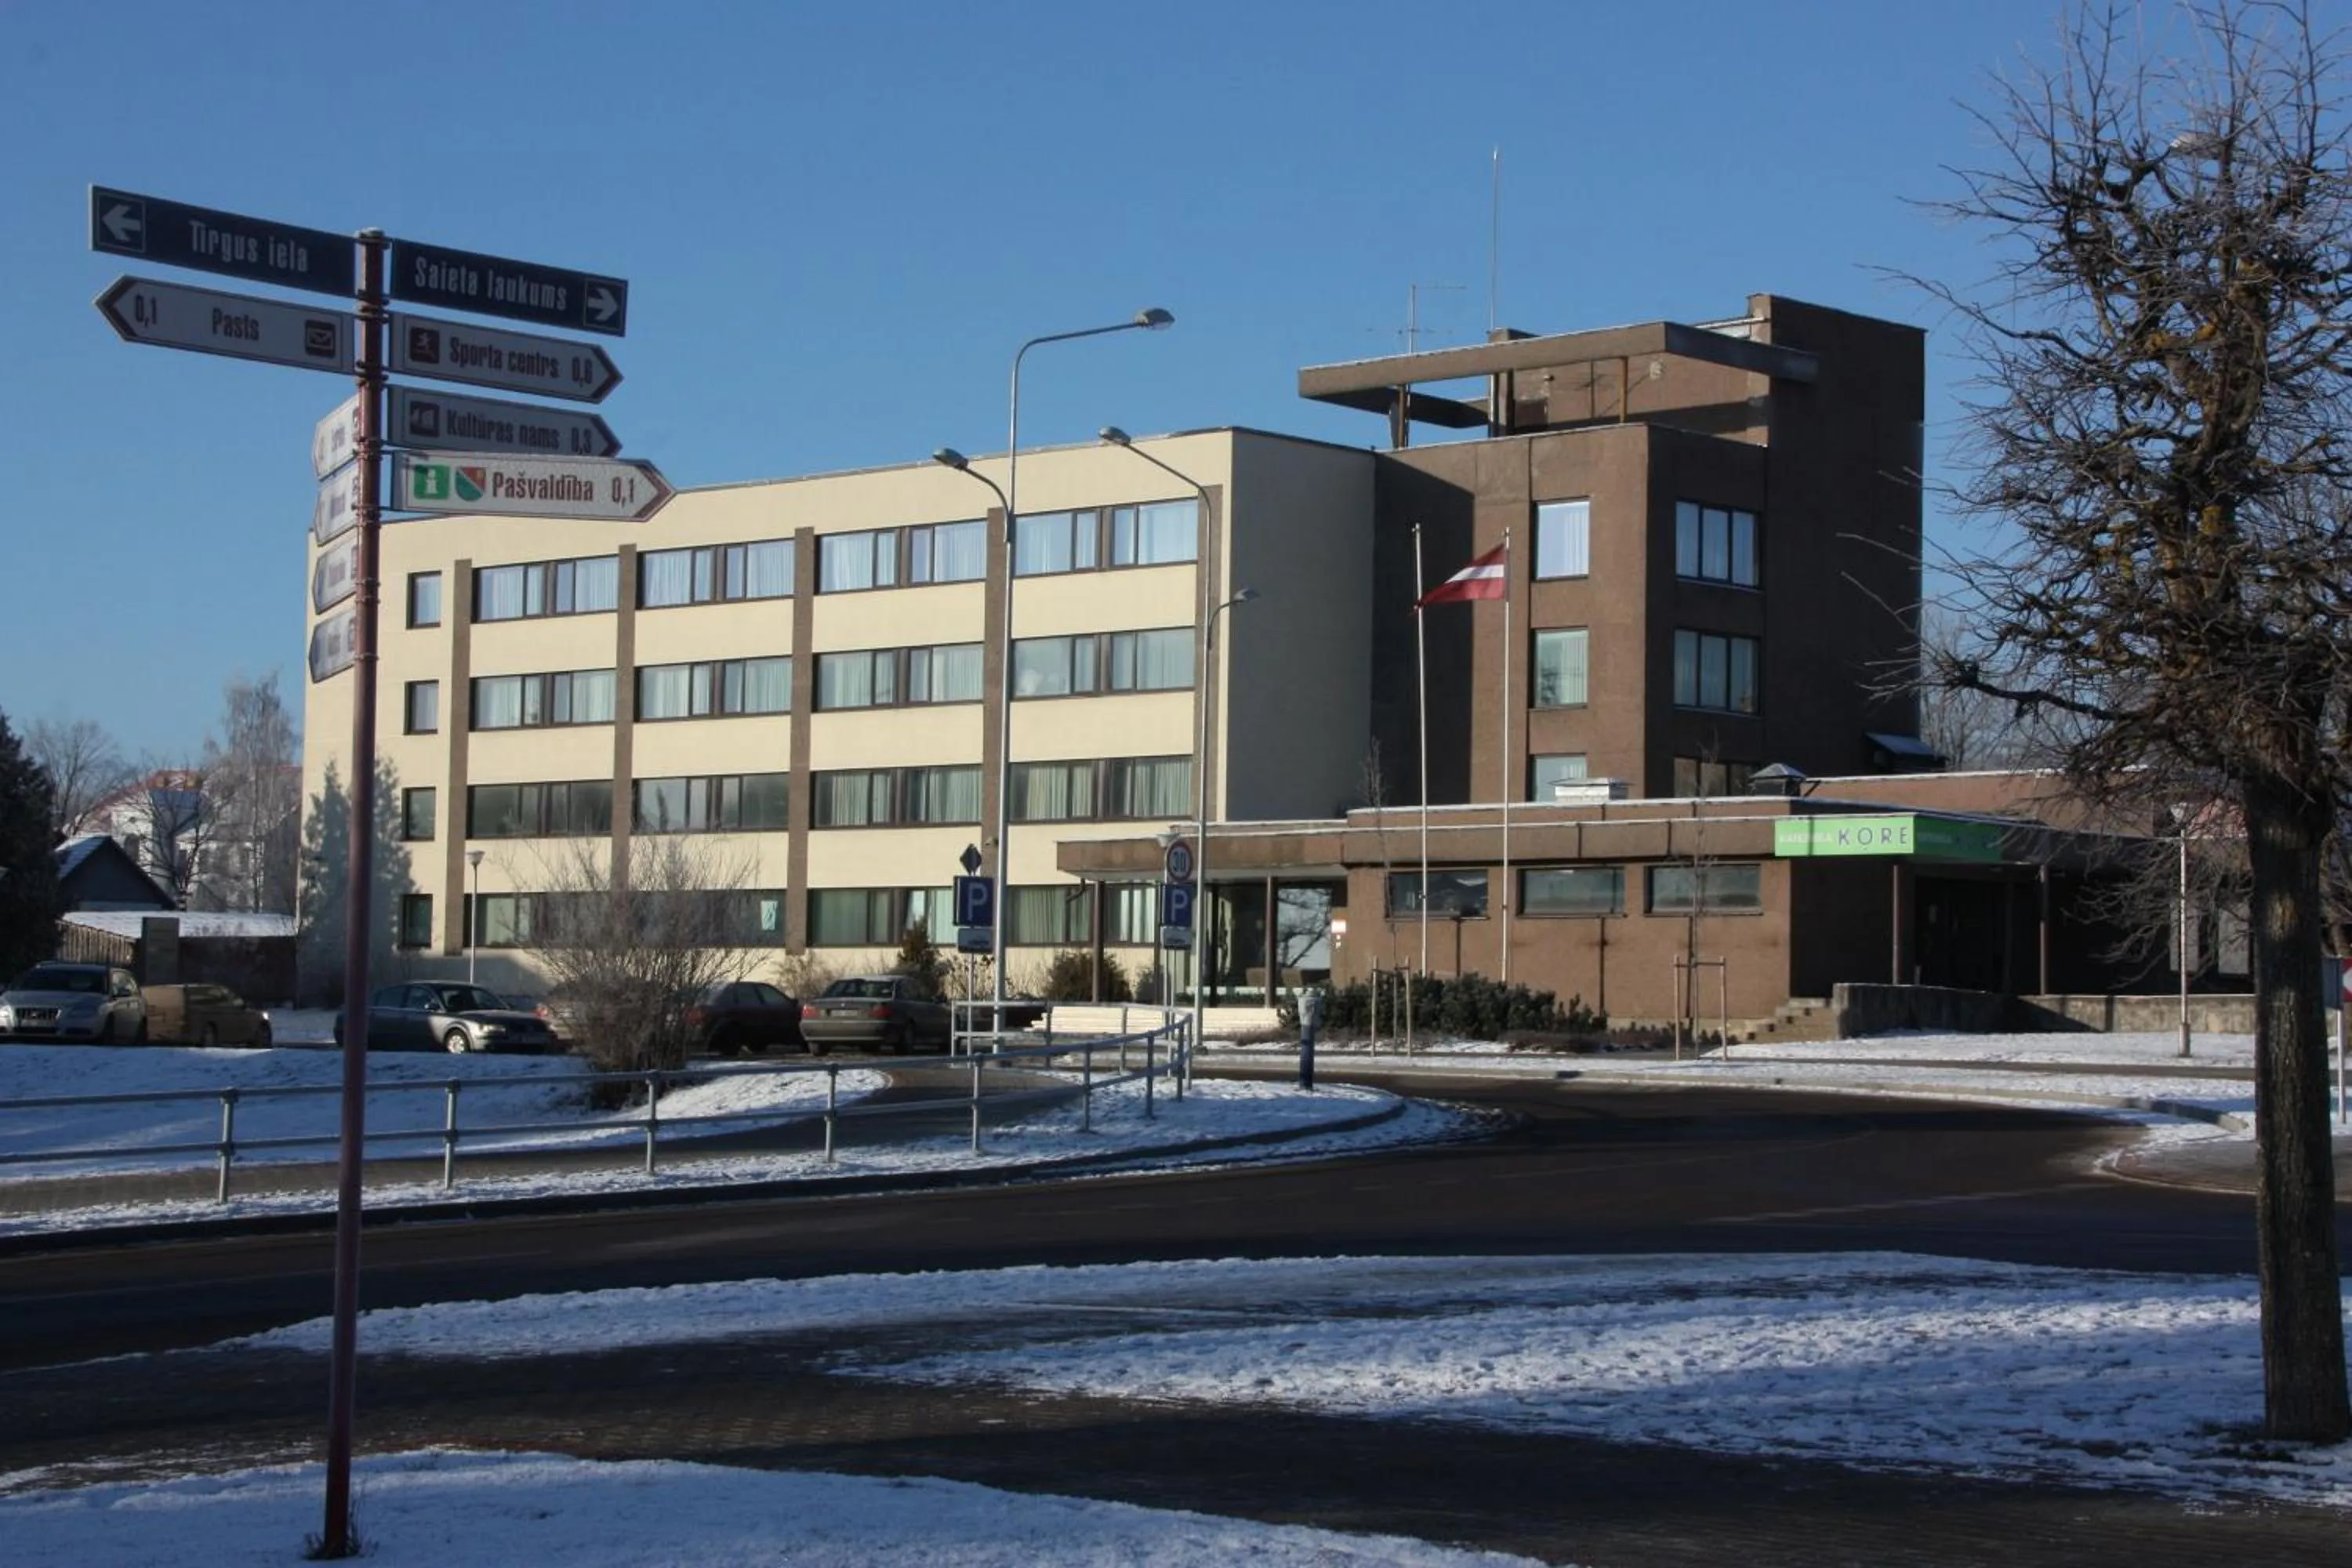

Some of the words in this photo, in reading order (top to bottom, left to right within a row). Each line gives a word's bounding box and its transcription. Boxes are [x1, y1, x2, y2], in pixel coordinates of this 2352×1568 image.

[189, 220, 259, 263] Tirgus
[269, 235, 309, 272] iela
[415, 256, 477, 296] Saieta
[487, 268, 568, 311] laukums
[135, 293, 157, 328] 0,1
[212, 307, 260, 341] Pasts
[449, 336, 503, 371] Sporta
[509, 349, 560, 379] centrs
[447, 408, 514, 444] Kultūras
[519, 424, 560, 450] nams
[492, 470, 593, 502] Pašvaldība
[612, 477, 635, 508] 0,1
[1838, 826, 1907, 846] KORE
[967, 882, 989, 923] P
[1171, 888, 1189, 924] P
